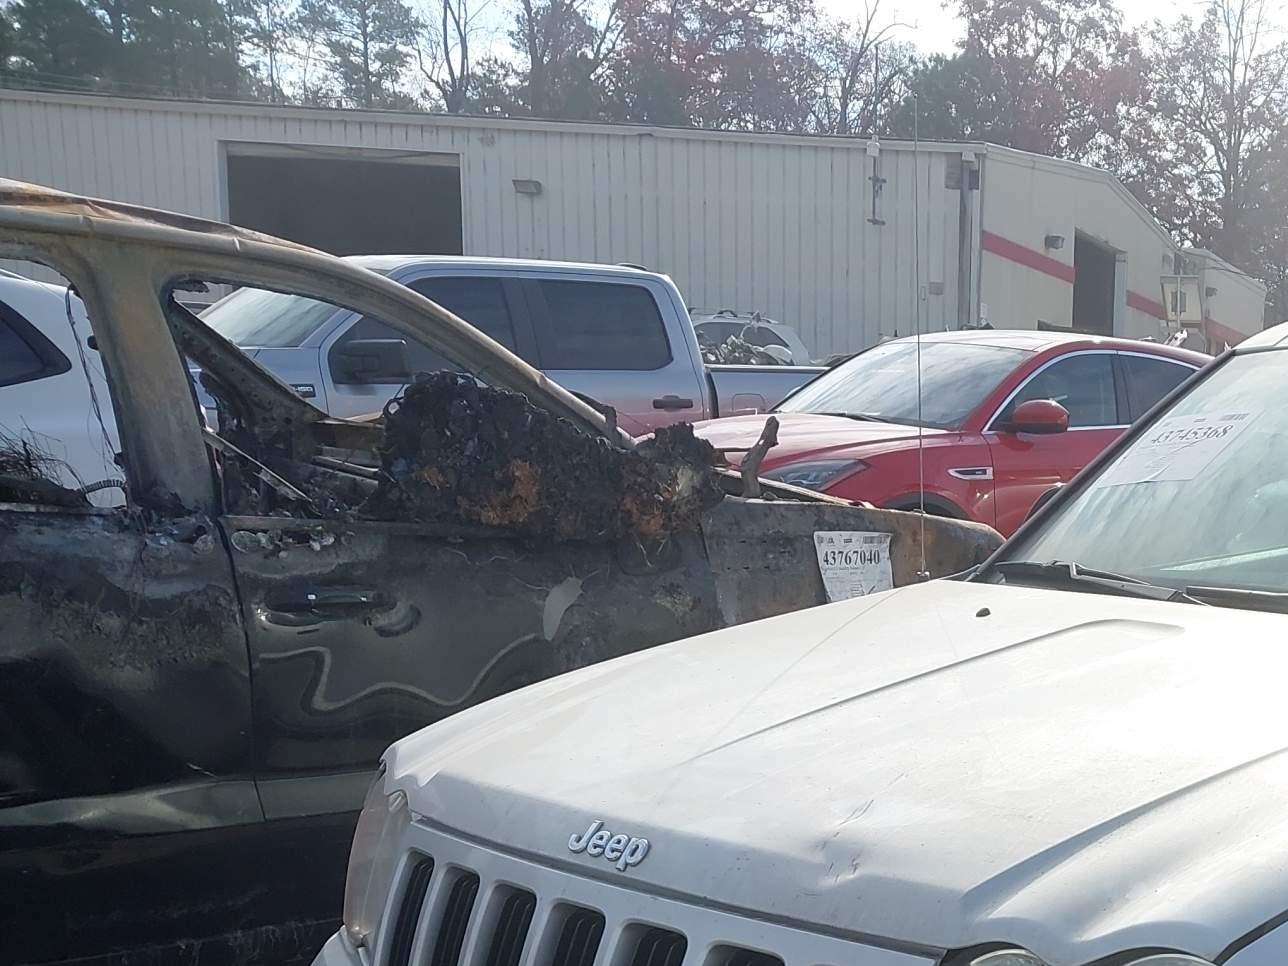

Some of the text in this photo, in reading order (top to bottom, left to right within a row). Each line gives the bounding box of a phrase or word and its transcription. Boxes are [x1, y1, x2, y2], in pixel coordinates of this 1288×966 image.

[1151, 424, 1234, 444] 43745368
[823, 549, 880, 566] 43767040
[568, 819, 650, 872] Jeep
